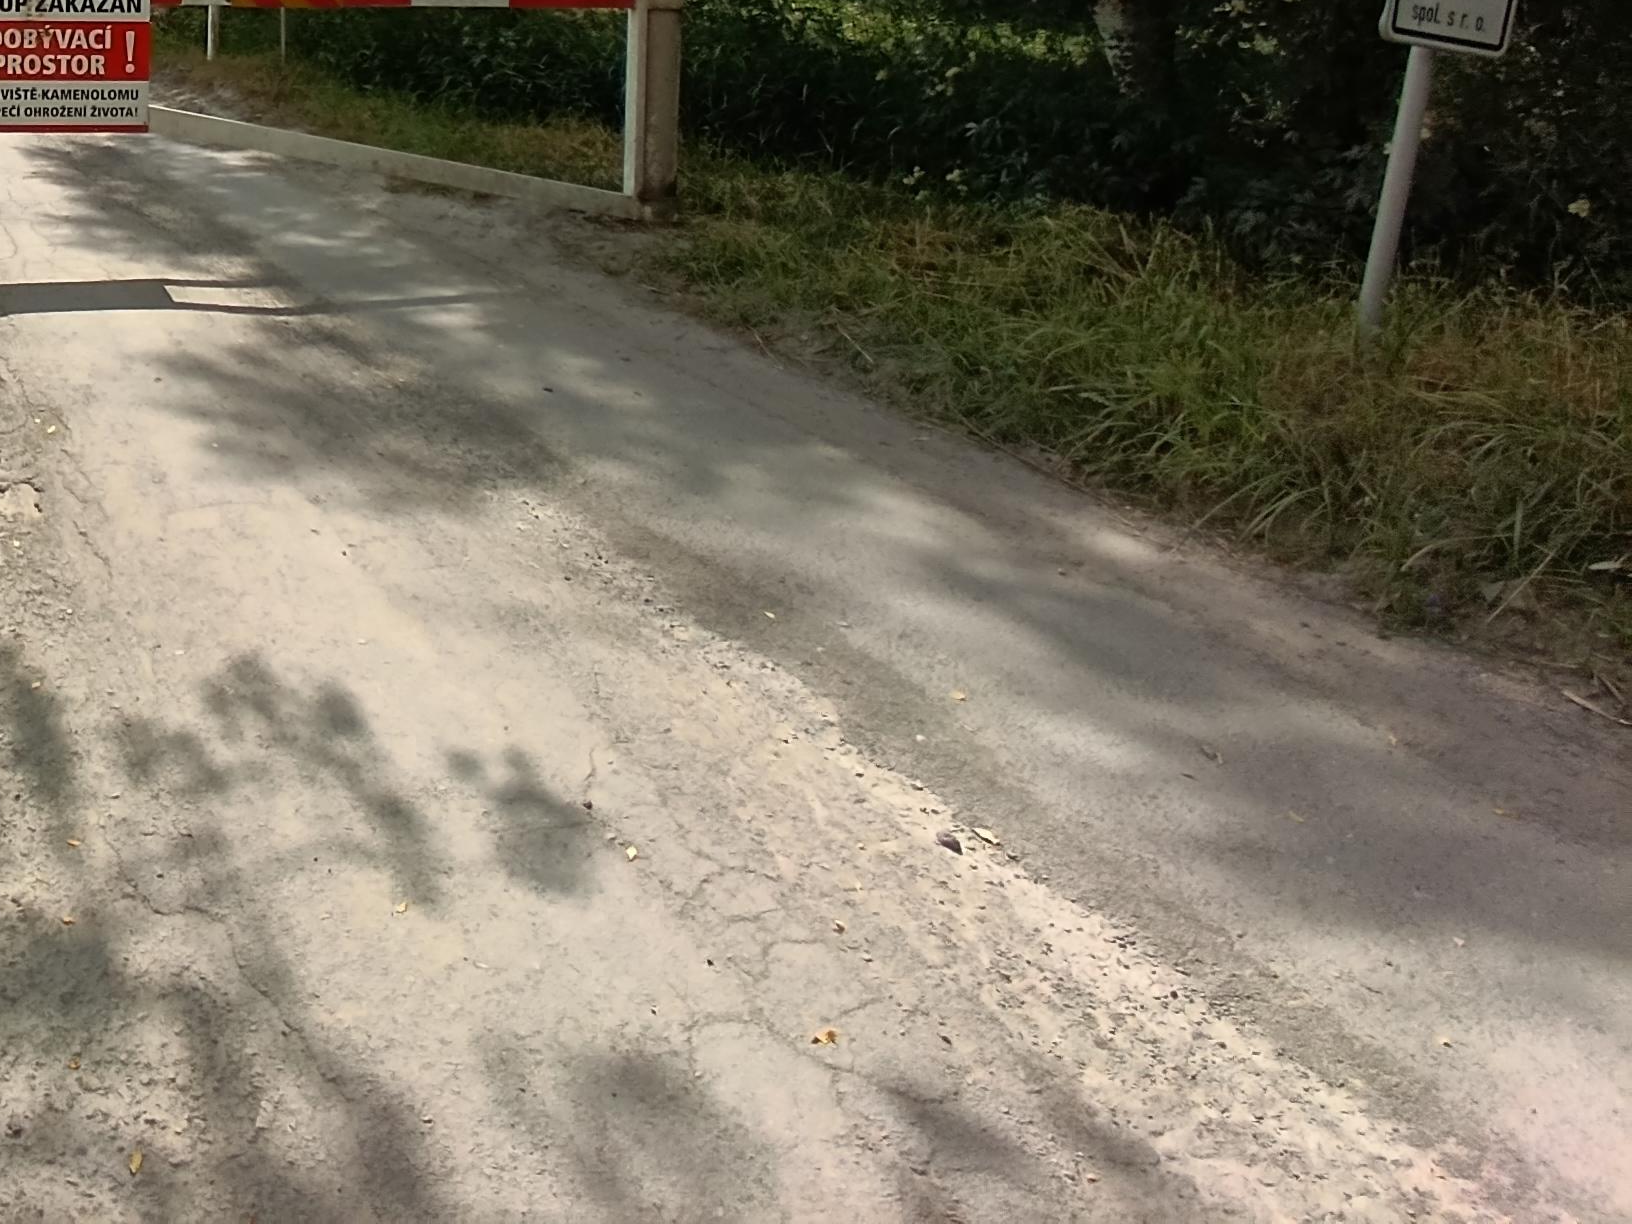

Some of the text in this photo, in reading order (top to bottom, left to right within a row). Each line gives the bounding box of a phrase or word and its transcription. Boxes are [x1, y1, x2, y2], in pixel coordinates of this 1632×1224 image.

[1447, 11, 1455, 26] s
[41, 89, 139, 101] KAMENOLOMU
[24, 106, 87, 118] OHROŽENÍ
[90, 106, 138, 118] ŽIVOTA!
